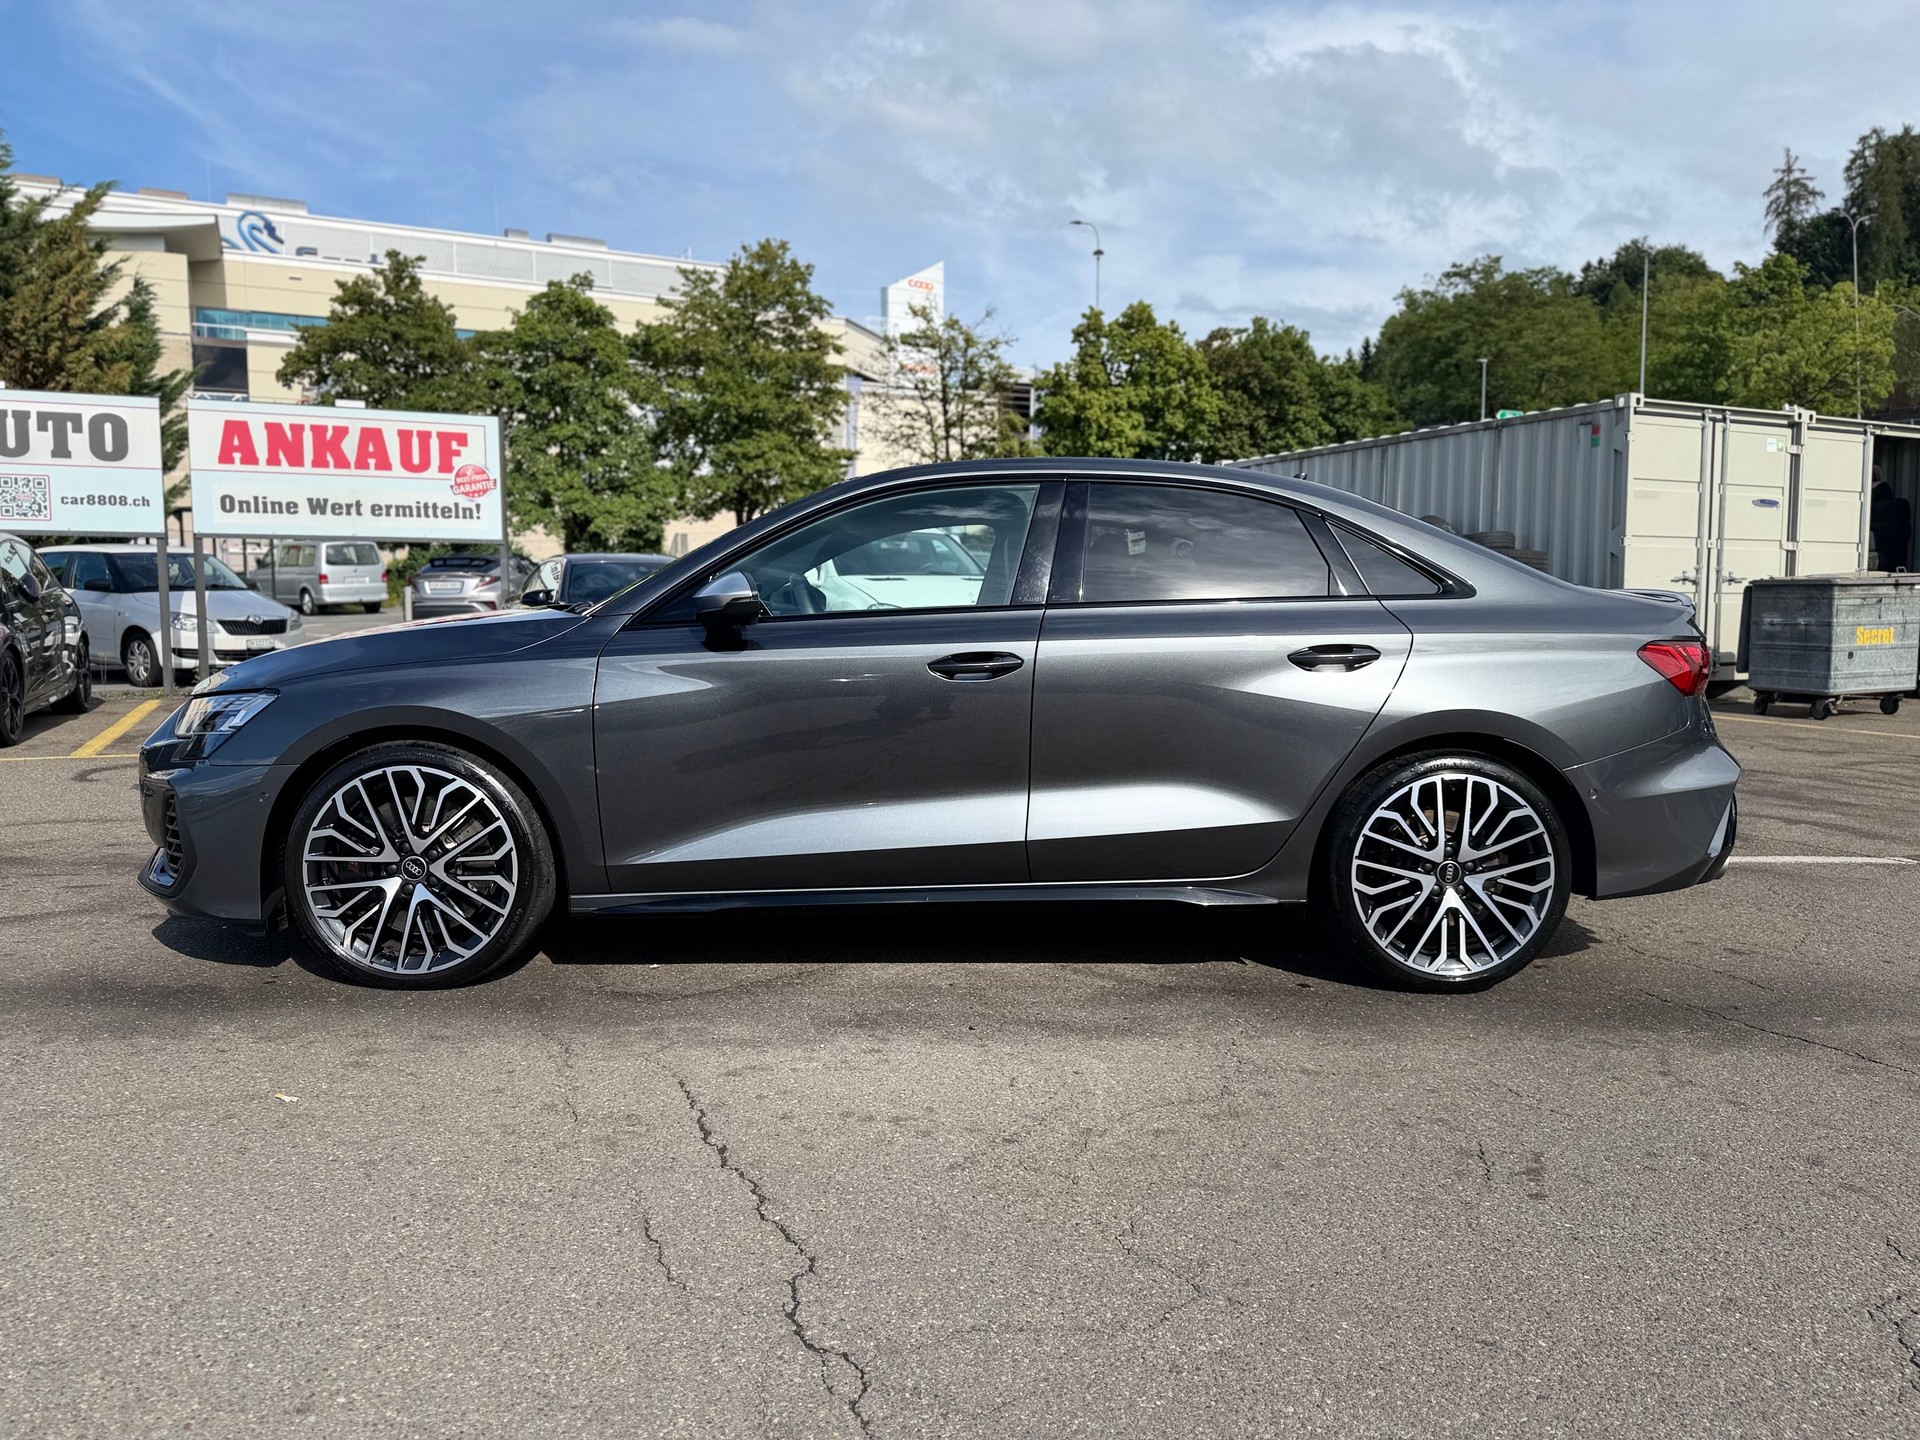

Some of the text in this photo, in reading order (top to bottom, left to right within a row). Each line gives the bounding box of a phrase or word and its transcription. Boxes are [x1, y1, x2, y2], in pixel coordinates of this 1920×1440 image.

[218, 419, 468, 474] ANKAUF
[452, 480, 496, 494] GARANTIE
[60, 494, 151, 507] car8808.ch
[220, 494, 481, 520] Online Wert ermitteln!
[1856, 625, 1894, 646] Secret
